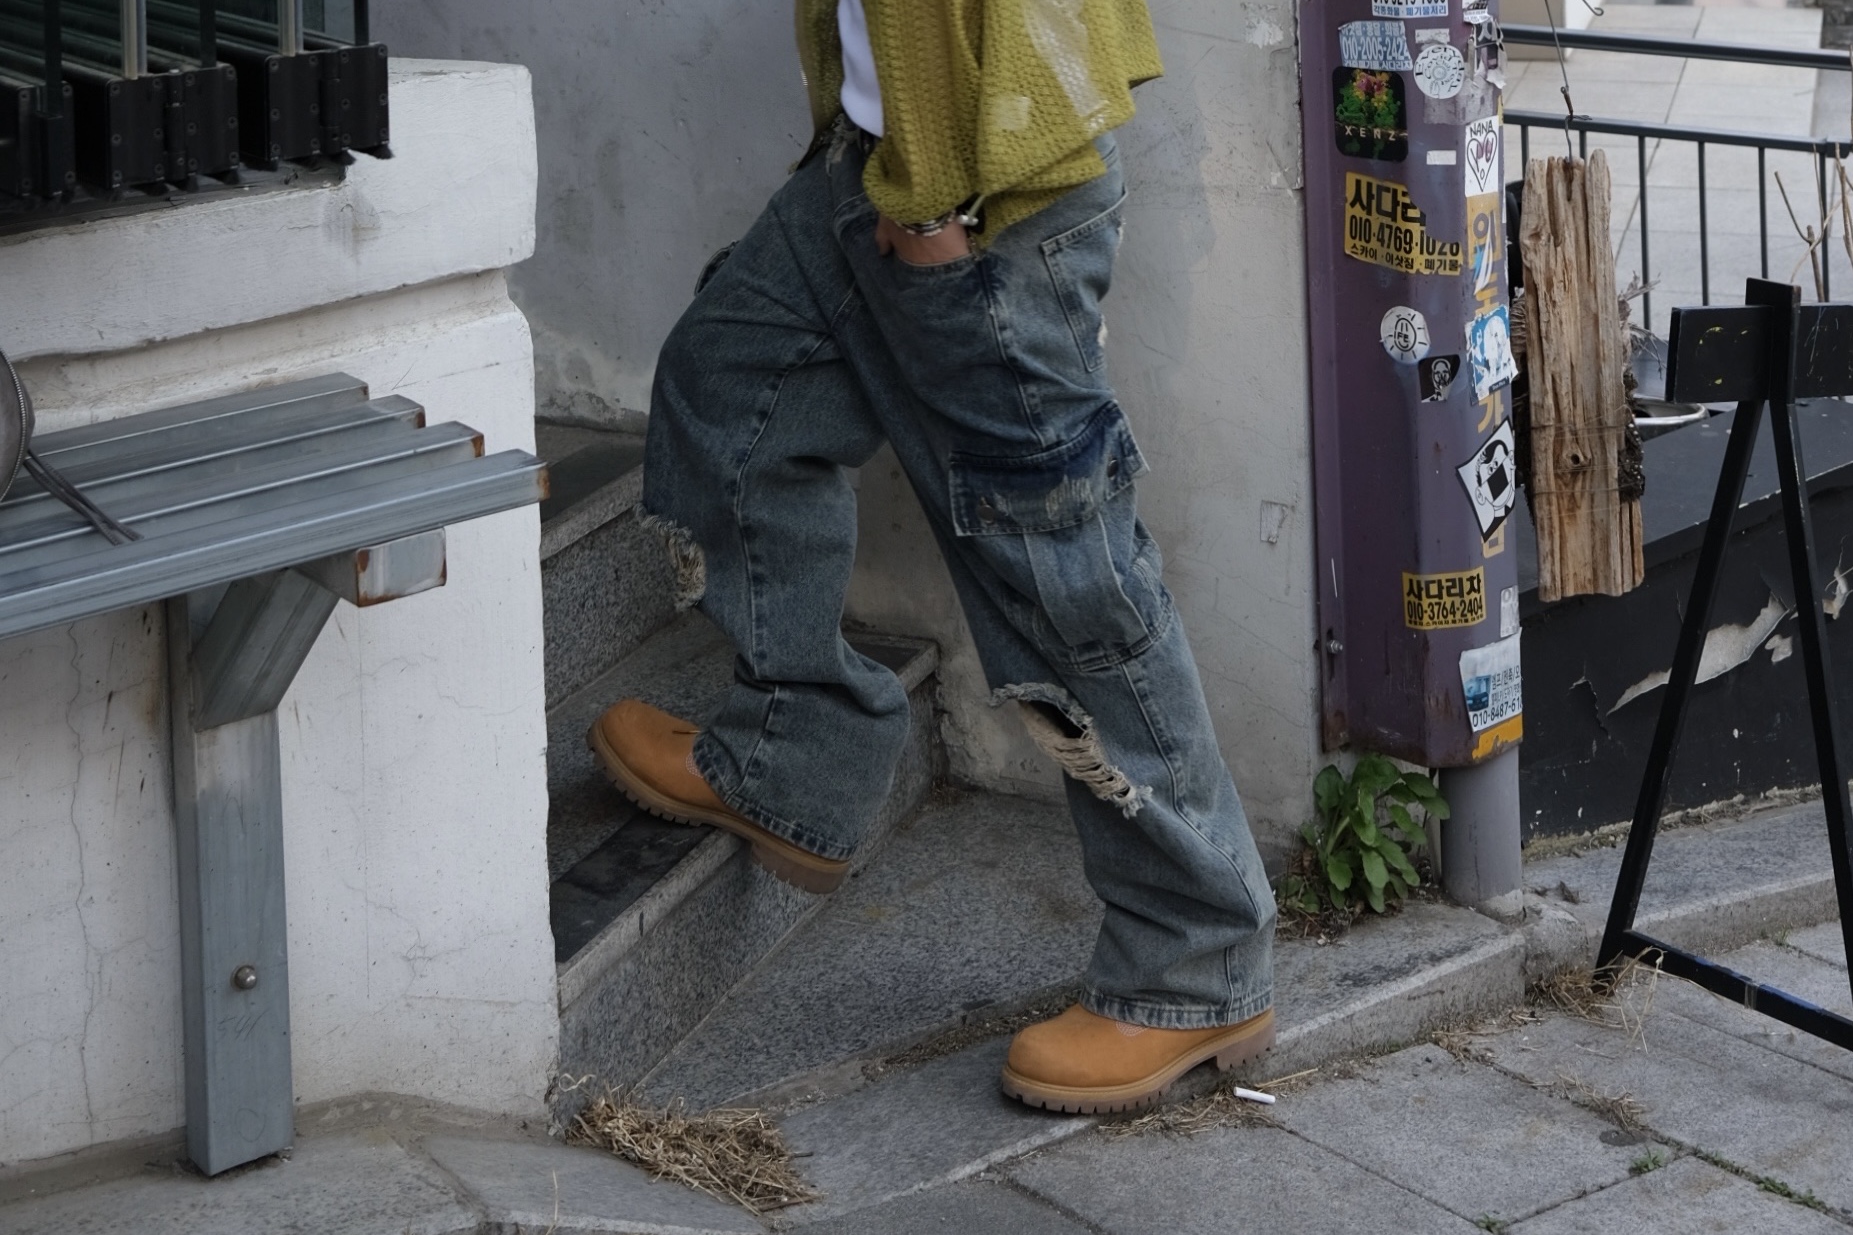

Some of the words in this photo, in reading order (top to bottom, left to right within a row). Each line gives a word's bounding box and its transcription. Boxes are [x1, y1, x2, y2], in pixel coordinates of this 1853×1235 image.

[1345, 125, 1396, 141] XENZ
[1469, 119, 1494, 138] NANA
[1350, 243, 1378, 261] 스카이
[1406, 572, 1482, 602] 사다리차
